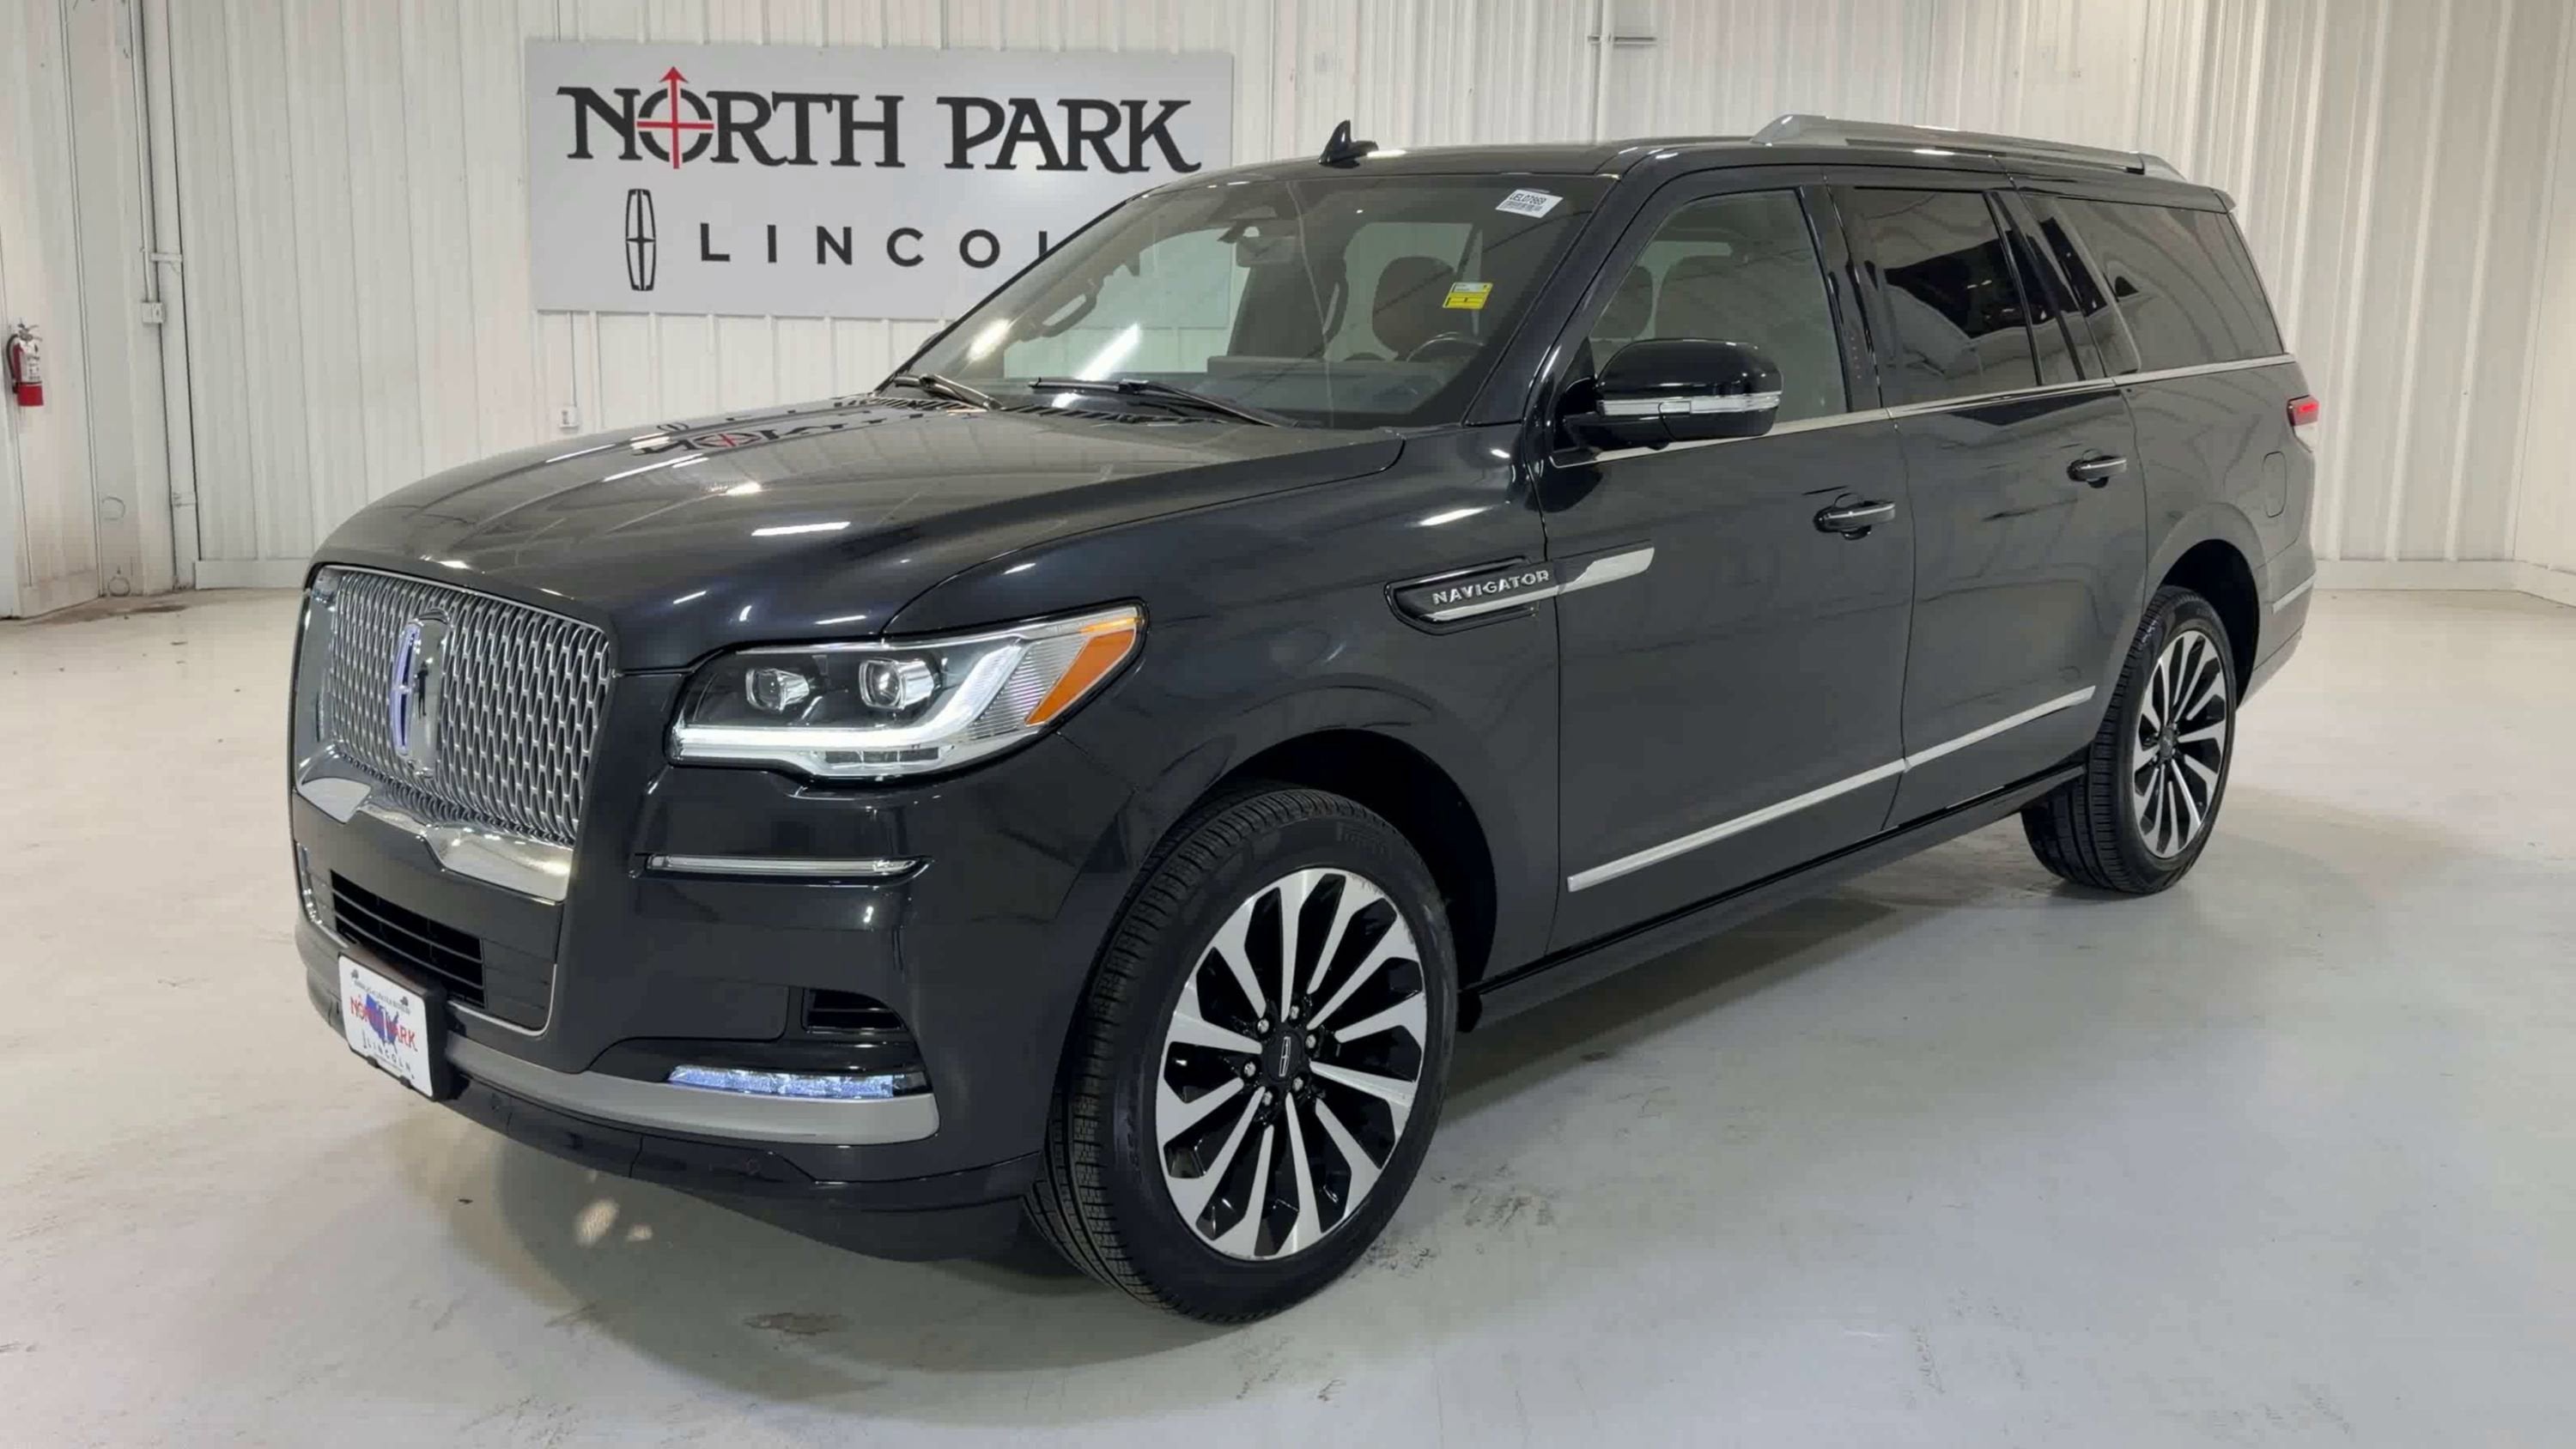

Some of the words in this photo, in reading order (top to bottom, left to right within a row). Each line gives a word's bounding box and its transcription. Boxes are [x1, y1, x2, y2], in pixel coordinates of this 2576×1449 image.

[556, 86, 906, 167] NORTH
[936, 96, 1202, 173] PARK
[1432, 569, 1550, 605] NAVIGATOR
